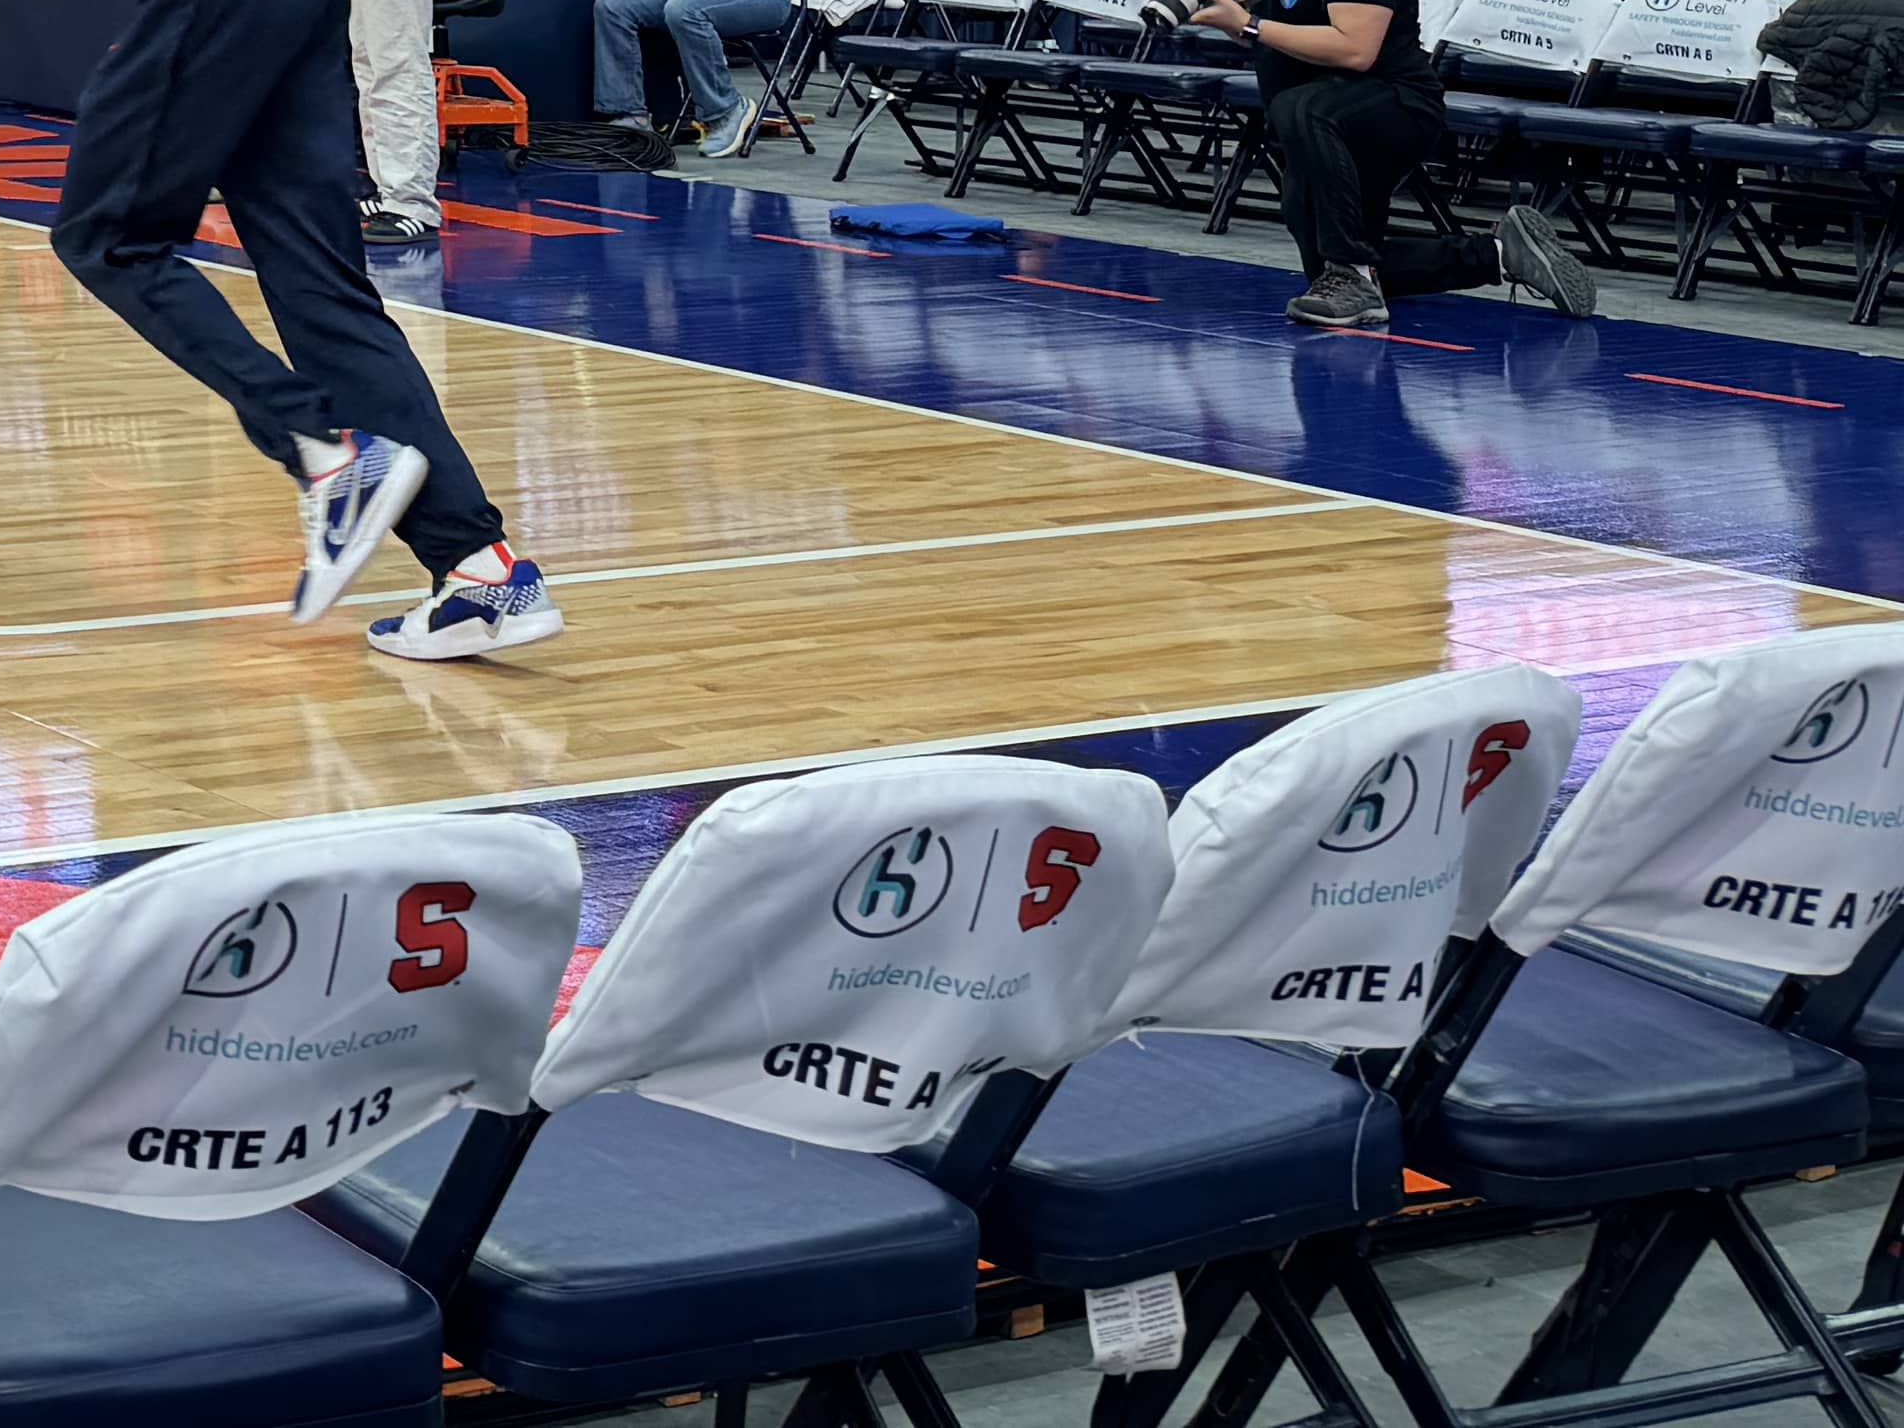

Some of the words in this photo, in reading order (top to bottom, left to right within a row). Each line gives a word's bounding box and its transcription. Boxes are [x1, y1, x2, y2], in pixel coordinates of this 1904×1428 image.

[1017, 824, 1102, 933] S
[1701, 873, 1818, 929] CRTE
[1827, 893, 1857, 931] A
[386, 880, 477, 994] S
[827, 964, 1033, 1002] hiddenlevel.com
[1269, 962, 1393, 1005] CRTE
[1397, 959, 1424, 1002] A
[166, 1018, 418, 1063] hiddenlevel.com
[761, 1040, 900, 1110] CRTE
[905, 1070, 942, 1112] A
[126, 1124, 266, 1172] CRTE
[274, 1124, 309, 1165] A
[325, 1085, 394, 1150] 113
